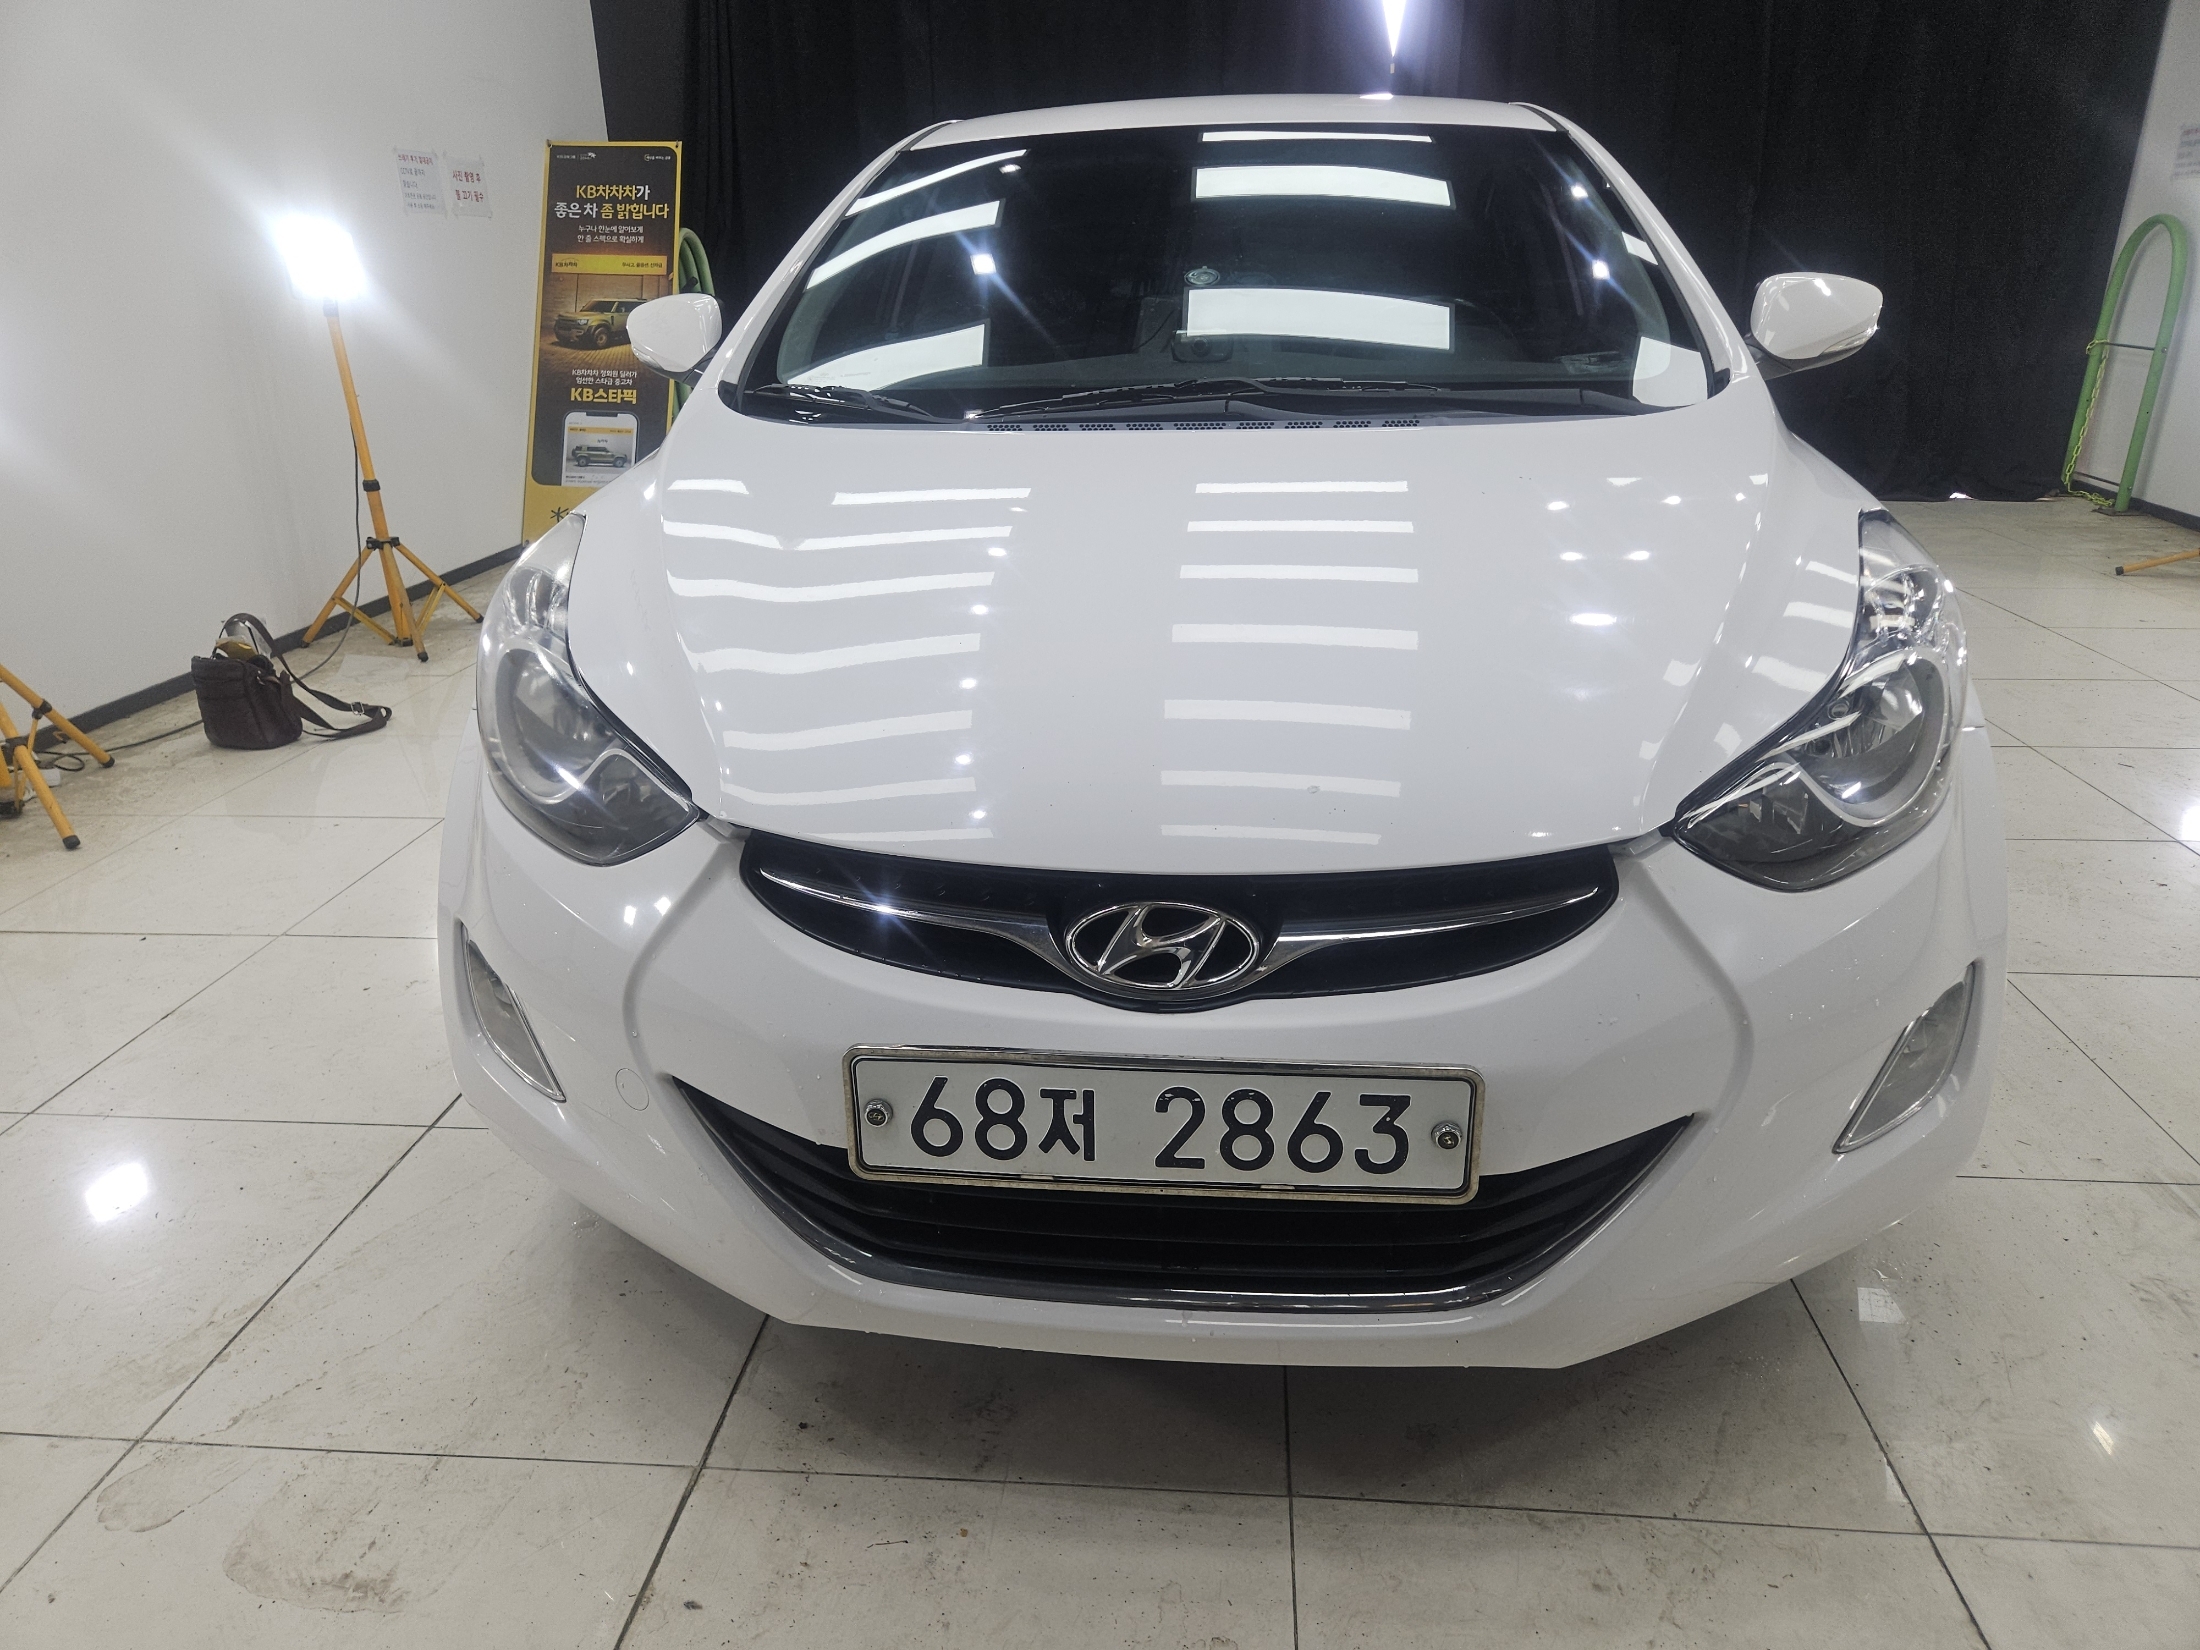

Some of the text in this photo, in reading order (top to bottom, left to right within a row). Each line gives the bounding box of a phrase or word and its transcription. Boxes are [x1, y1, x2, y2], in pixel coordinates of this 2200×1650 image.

[452, 170, 482, 183] 사진 촬영 후
[576, 185, 651, 200] KB차차차가
[554, 202, 670, 220] 좋은 차 좀 밝힙니다
[578, 225, 644, 234] 누구나 한눈에 알아보게
[577, 235, 645, 244] 한 줄 스펙으로 확실하게
[572, 369, 638, 378] KB차차차 정회원 딜러가
[575, 377, 633, 386] 엄선한 스타급 중고차
[570, 387, 637, 405] KB스타픽
[909, 1074, 1413, 1175] 68저 2863
